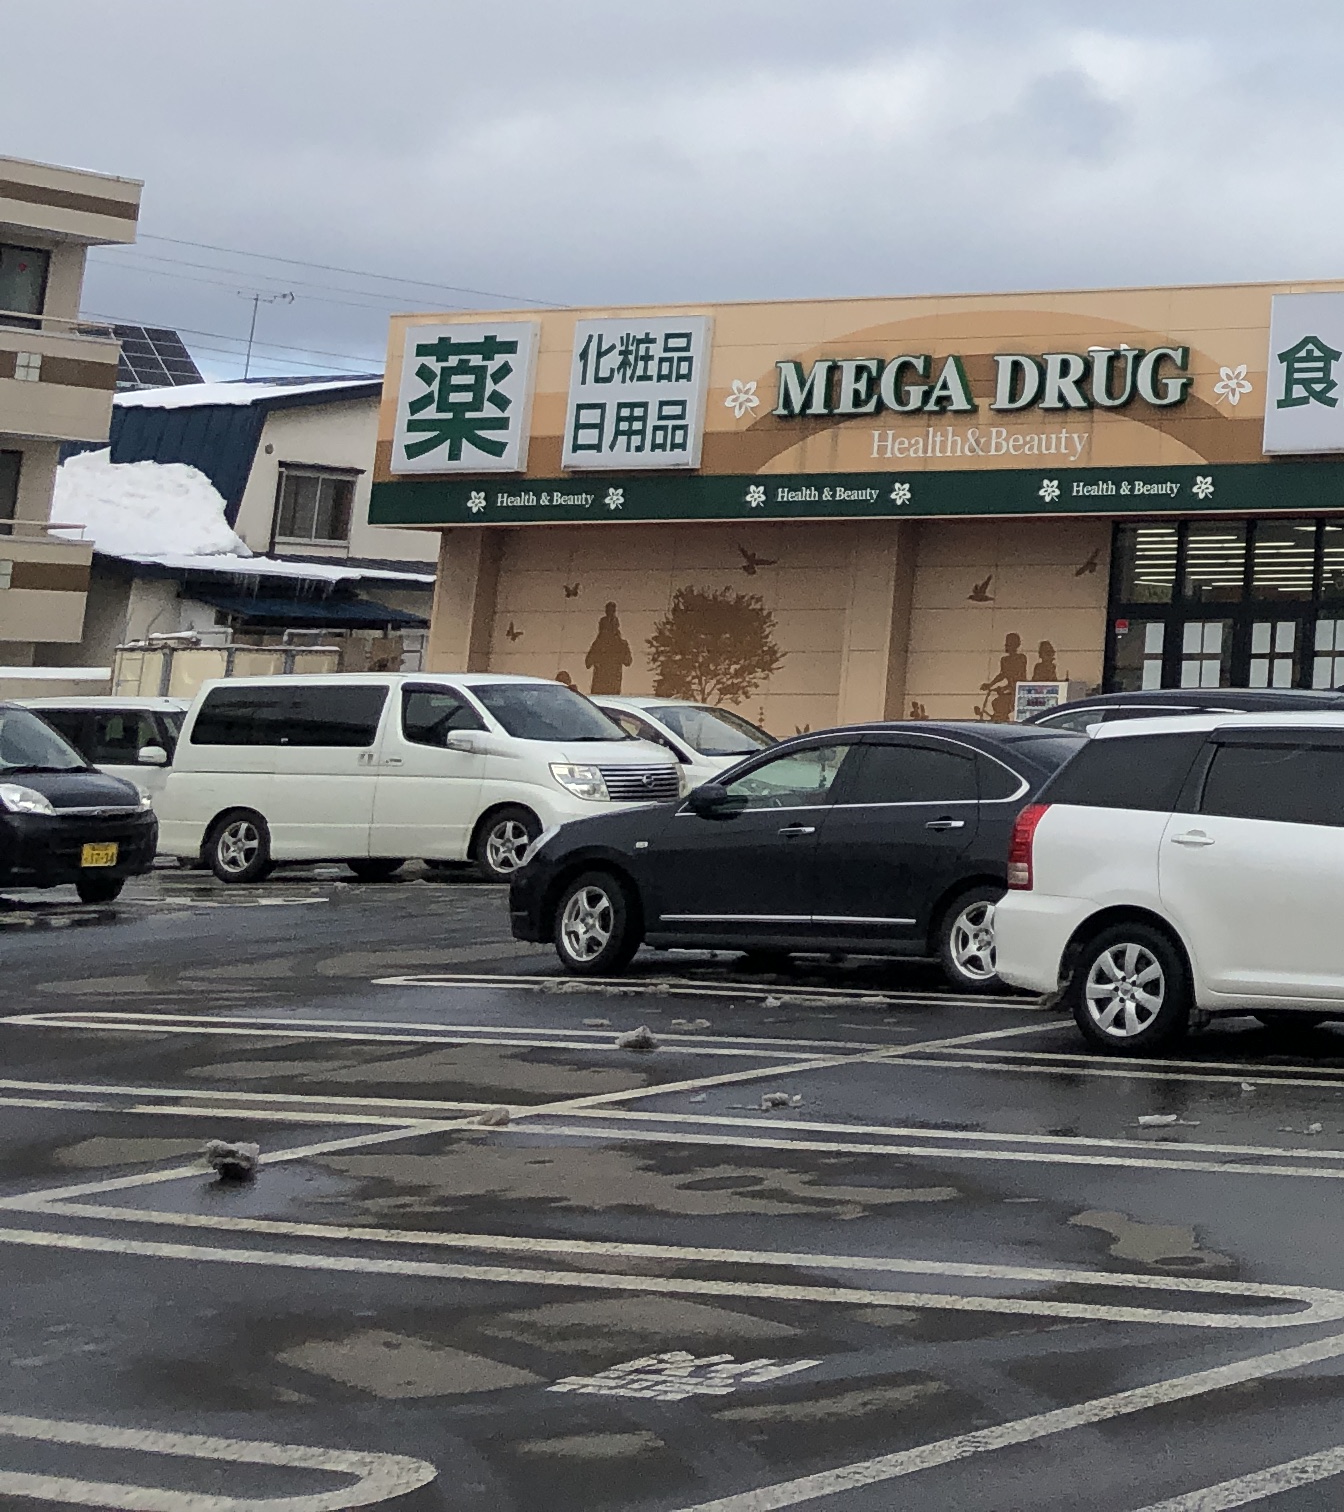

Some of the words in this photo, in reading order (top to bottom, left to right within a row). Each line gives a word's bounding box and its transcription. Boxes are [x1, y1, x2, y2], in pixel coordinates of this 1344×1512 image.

[578, 332, 693, 386] 化粧品
[403, 334, 518, 461] 薬
[772, 354, 977, 417] MEGA
[989, 346, 1193, 412] DRUG
[571, 399, 688, 454] 日用品
[870, 426, 1089, 461] Health&Beauty
[496, 491, 537, 506] Health
[539, 492, 551, 505] &
[552, 491, 594, 508] Beauty
[777, 487, 819, 501] Health
[822, 487, 833, 501] &
[835, 487, 879, 502] Beauty
[1072, 481, 1116, 496] Health
[1120, 481, 1131, 495] &
[1134, 481, 1180, 497] Beauty
